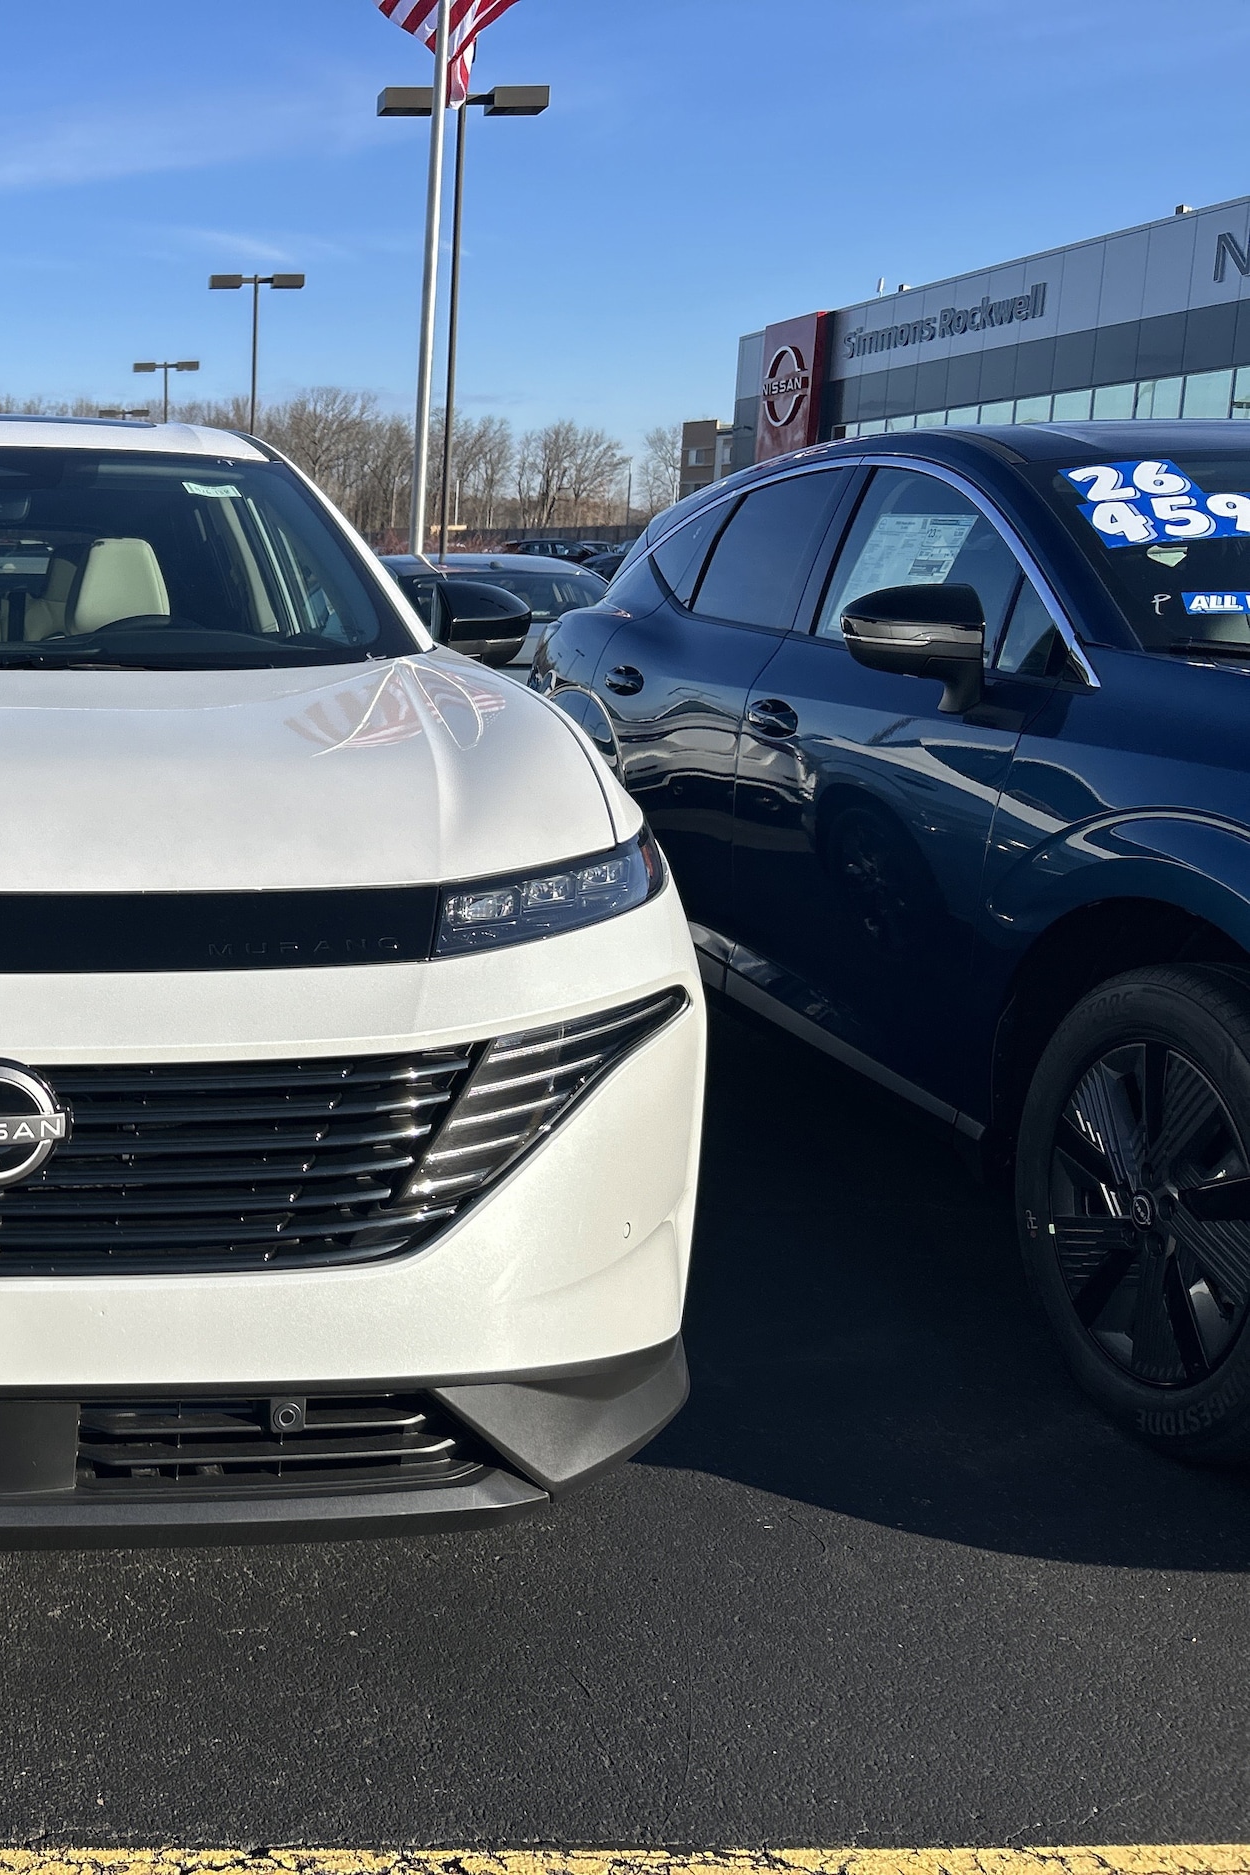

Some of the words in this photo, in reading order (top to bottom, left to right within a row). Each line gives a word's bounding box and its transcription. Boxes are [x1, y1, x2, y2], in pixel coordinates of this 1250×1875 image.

[843, 316, 938, 360] Simmons
[938, 282, 1048, 339] Rockwell
[762, 376, 802, 396] NISSAN
[1068, 461, 1191, 502] 26
[1092, 493, 1250, 543] 459
[1189, 594, 1244, 613] ALL
[208, 937, 399, 957] MURANO
